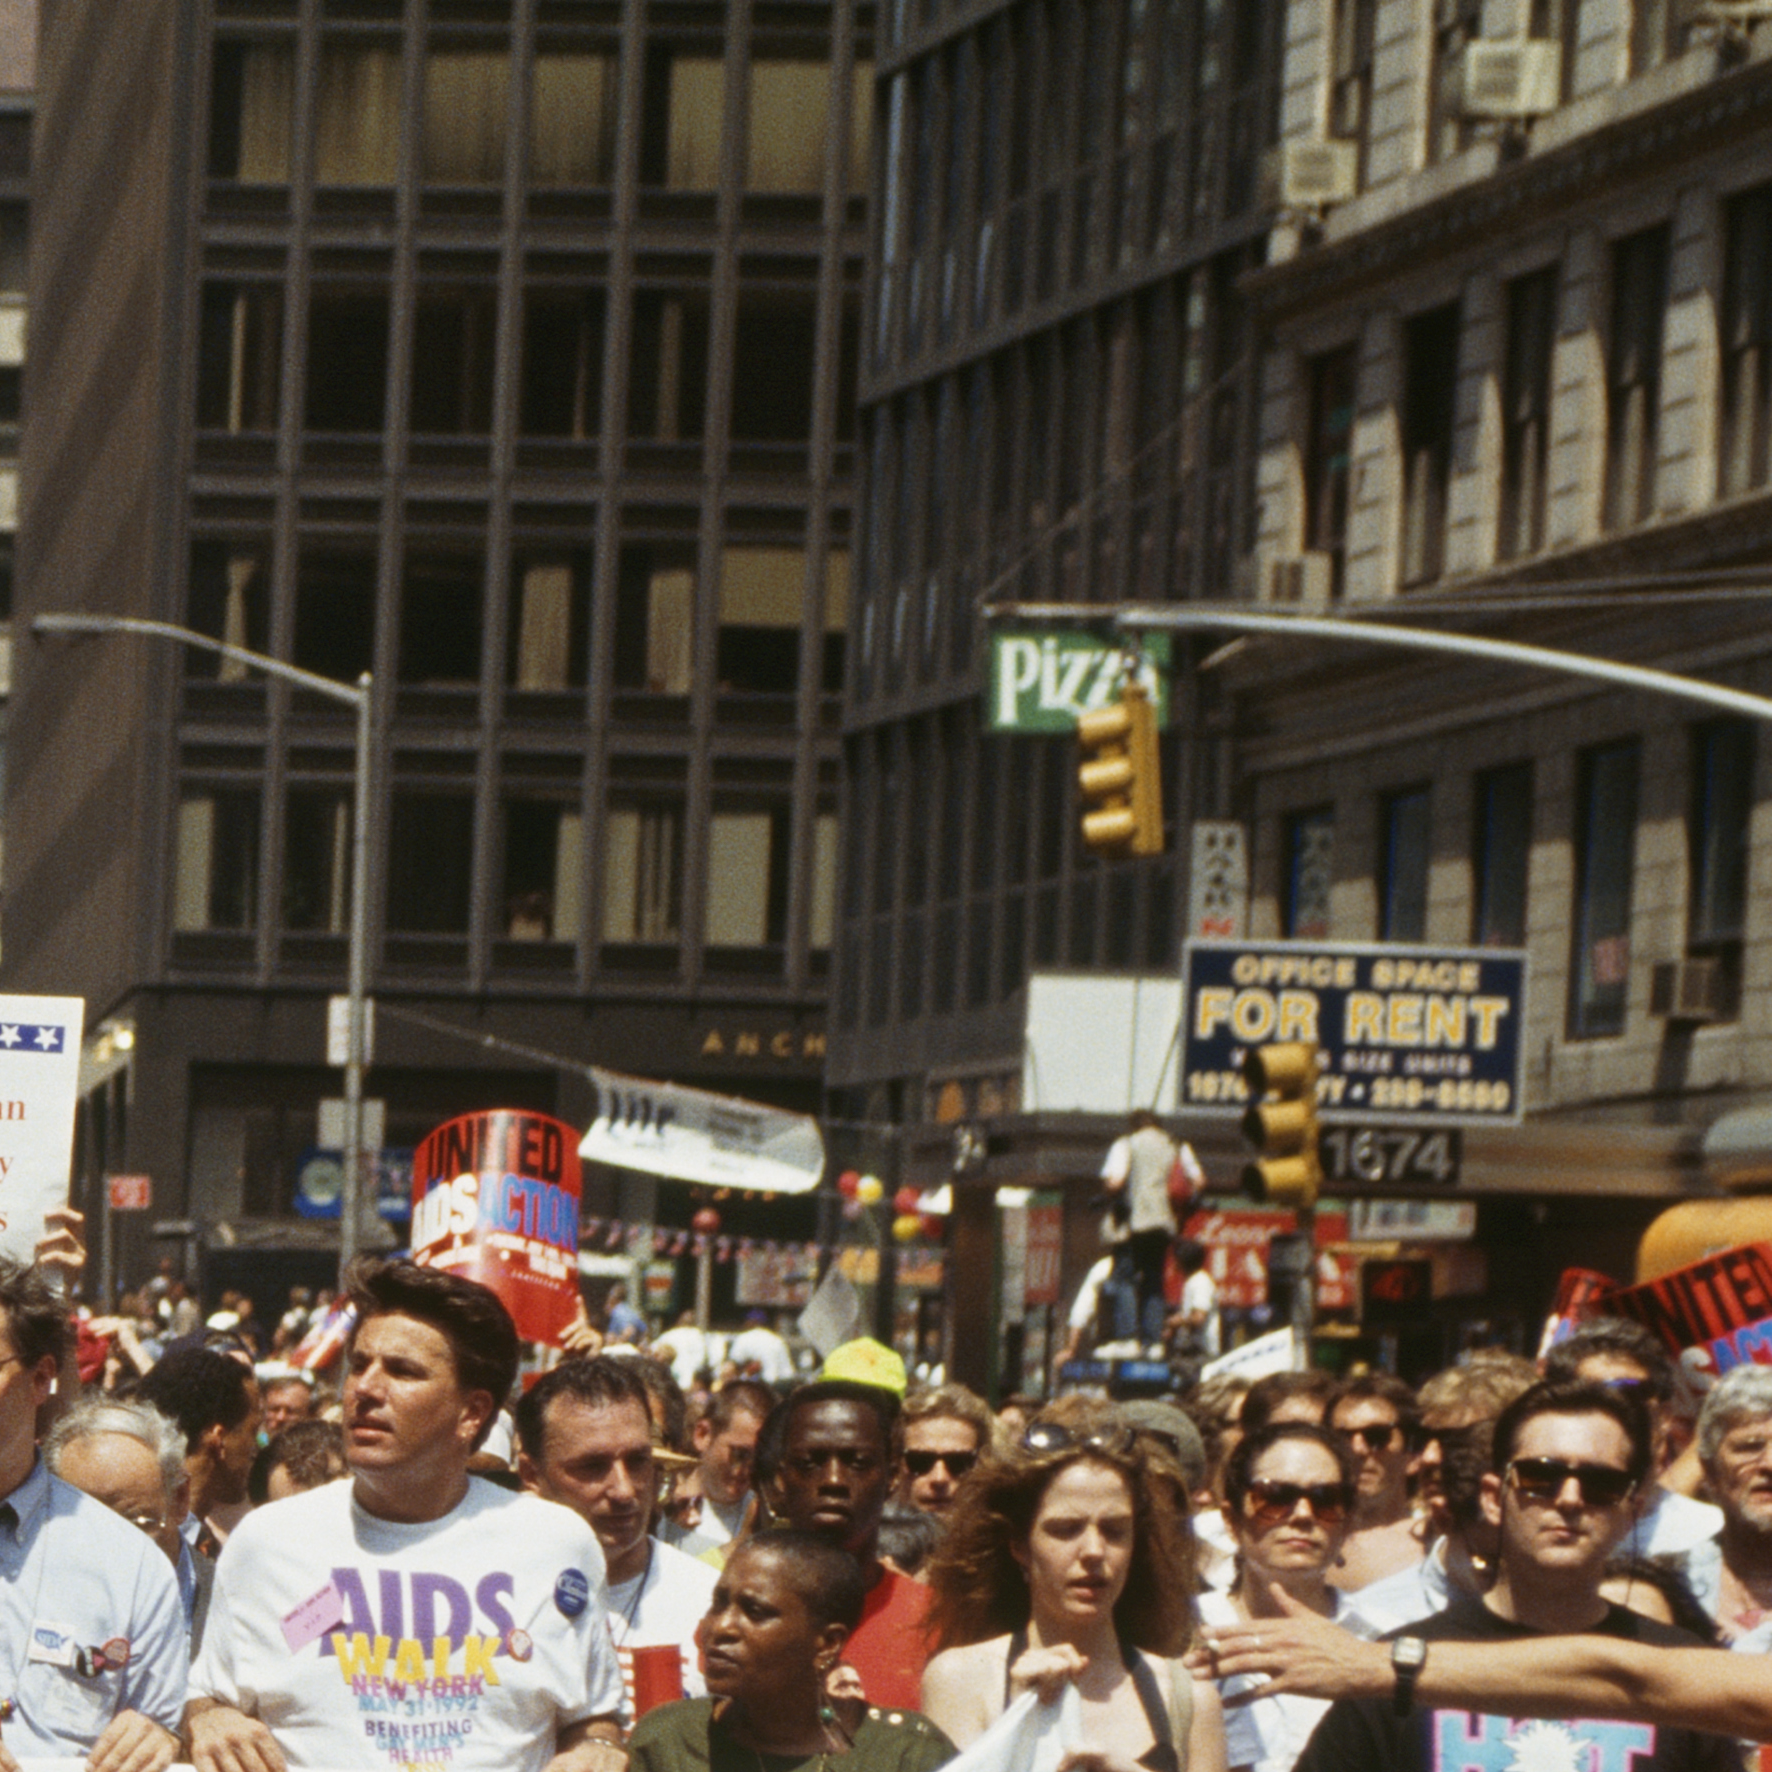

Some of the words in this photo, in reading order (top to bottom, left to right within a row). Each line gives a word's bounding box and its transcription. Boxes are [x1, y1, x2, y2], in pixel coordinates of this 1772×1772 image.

[1231, 954, 1355, 987] OFFICE
[1371, 957, 1480, 993] SPACE
[1194, 986, 1320, 1042] FOR
[1344, 992, 1510, 1050] RENT
[426, 1113, 564, 1185] UNITED
[1325, 1130, 1455, 1182] 1674
[318, 1566, 517, 1660] AIDS
[330, 1630, 502, 1690] WALK
[350, 1672, 408, 1700] NEW
[416, 1672, 485, 1698] YORK
[358, 1695, 397, 1714] MAY
[364, 1718, 474, 1740] BENEFITING
[388, 1746, 454, 1765] HEALTH
